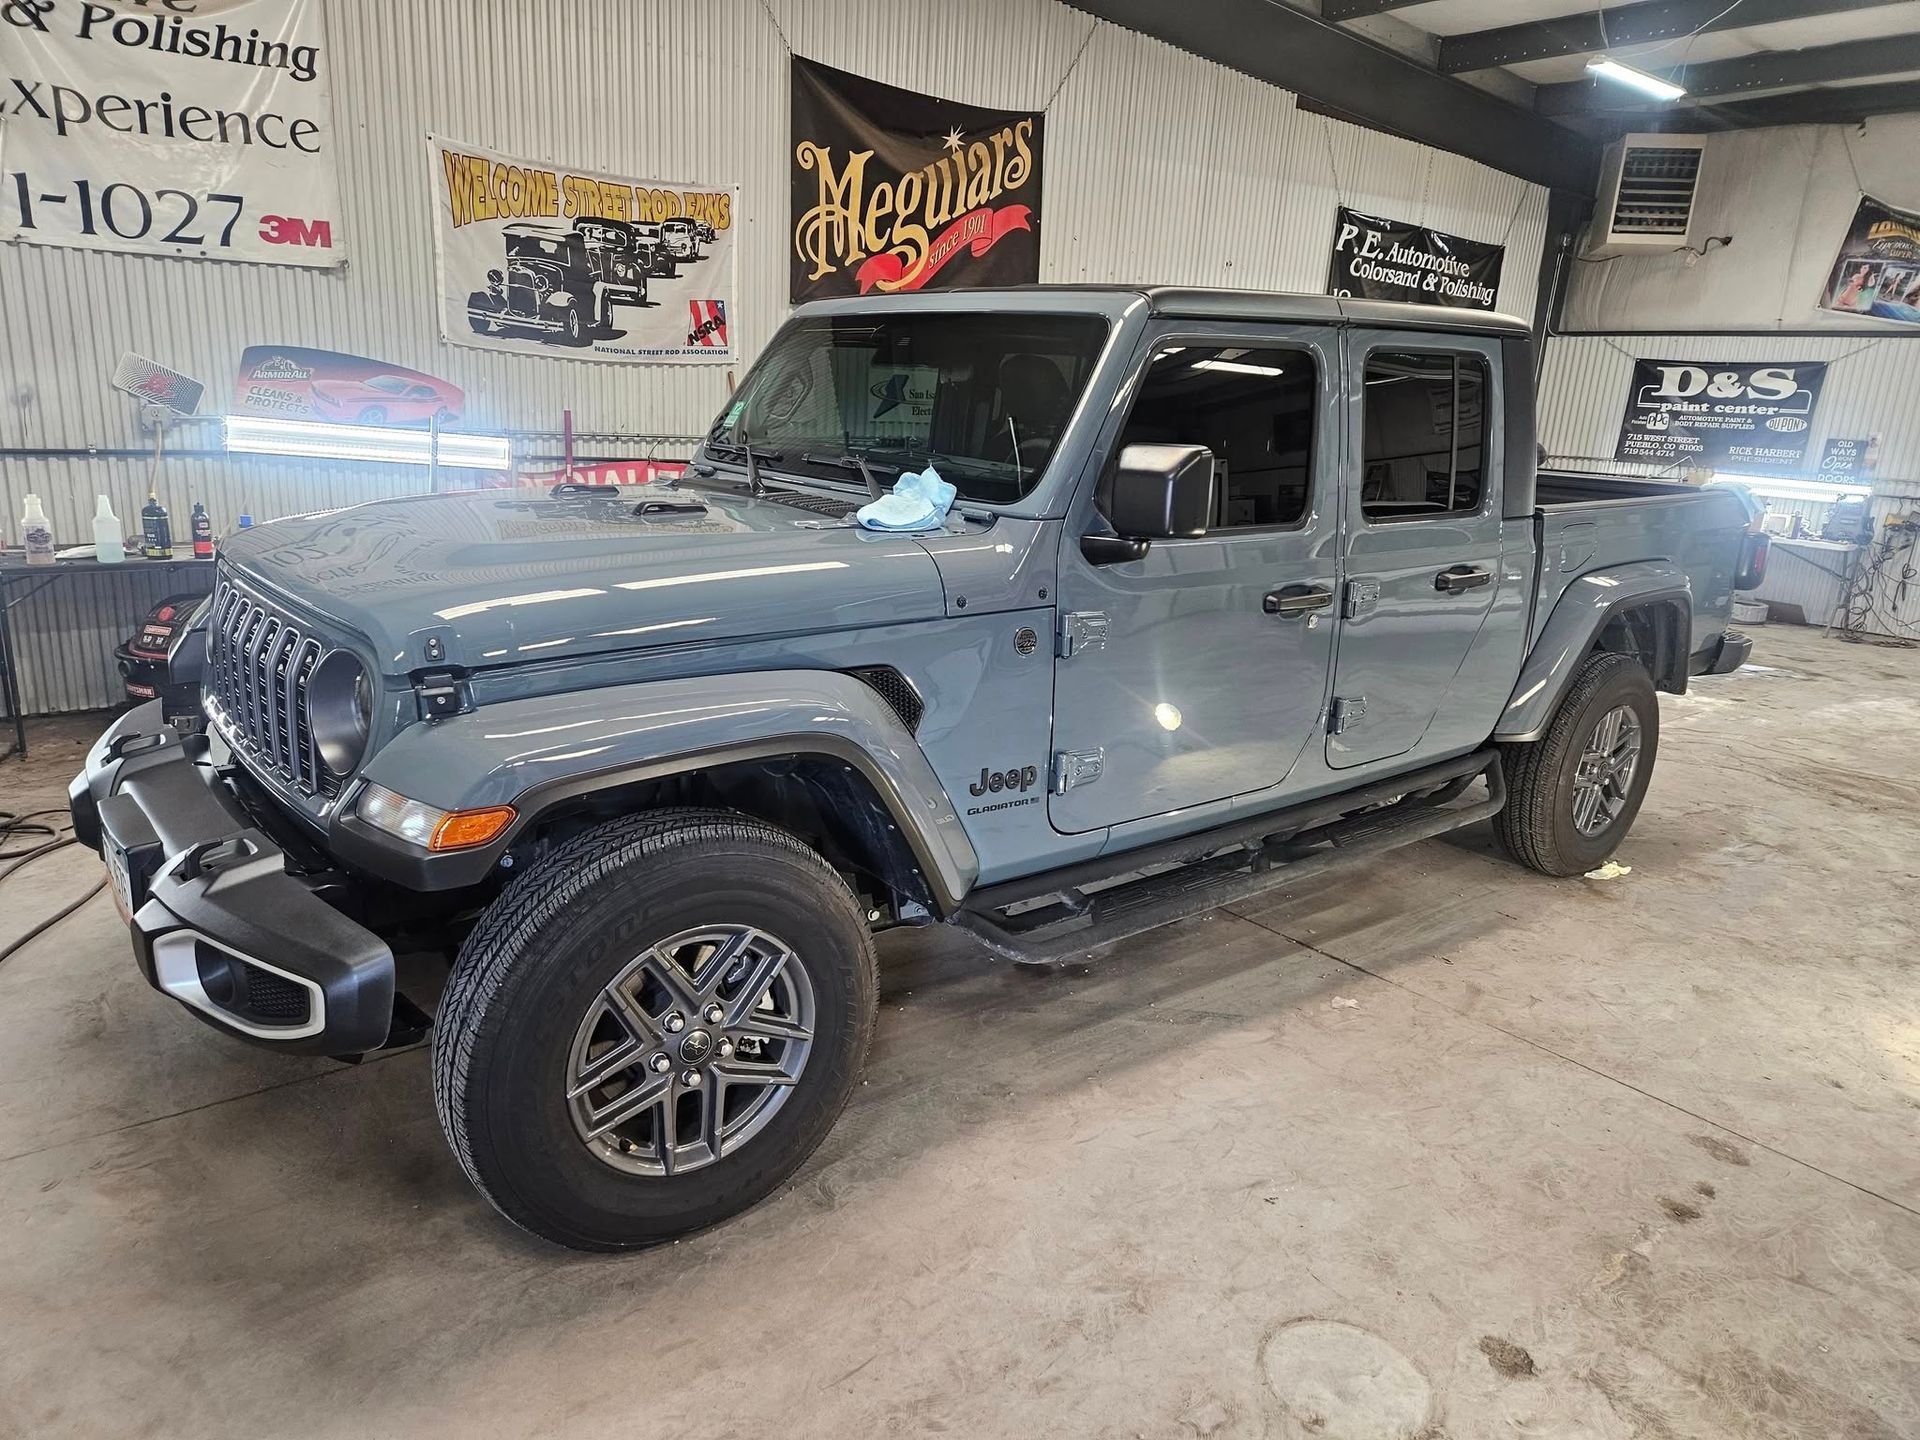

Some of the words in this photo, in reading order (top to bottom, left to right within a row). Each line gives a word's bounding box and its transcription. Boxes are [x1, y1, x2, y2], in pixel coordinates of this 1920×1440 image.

[75, 1, 321, 82] Polishing
[0, 78, 322, 153] xperience
[441, 149, 560, 229] WELCOME
[562, 174, 634, 225] STREET
[635, 186, 683, 224] ROD
[682, 191, 731, 230] FANS
[258, 214, 333, 248] 3M
[928, 230, 960, 269] since
[962, 213, 987, 241] 1901
[1335, 222, 1384, 261] P.E.
[1385, 241, 1471, 278] Automotive
[1350, 257, 1422, 289] Colorsand
[1422, 272, 1439, 292] &
[1439, 277, 1496, 306] Polishing
[687, 315, 727, 347] NSRA
[594, 345, 636, 356] NATIONAL
[637, 348, 663, 356] STREET
[664, 348, 681, 356] ROD
[681, 348, 730, 356] ASSOCIATION
[1651, 366, 1798, 400] D&S
[249, 385, 294, 401] CLEANS
[909, 388, 924, 399] San
[245, 395, 310, 415] PROTECTS
[1660, 401, 1711, 413] paint
[1714, 403, 1780, 415] center
[1679, 414, 1724, 422] AUTOMOTIVE
[1721, 422, 1755, 430] SUPPLIES
[1627, 433, 1642, 441] 715
[1643, 434, 1667, 442] WEST
[1667, 436, 1700, 444] STREET
[1837, 440, 1854, 448] OLD
[1624, 447, 1639, 455] 719
[1663, 442, 1676, 450] CO
[1678, 444, 1704, 452] 81003
[1728, 446, 1753, 456] RICK
[1755, 447, 1802, 459] HARBERT
[1831, 447, 1857, 456] WAYS
[1730, 455, 1796, 465] PRESIDENT
[1817, 473, 1855, 484] DOORS
[970, 765, 1037, 796] Jeep
[967, 798, 1029, 815] GLADIATOR
